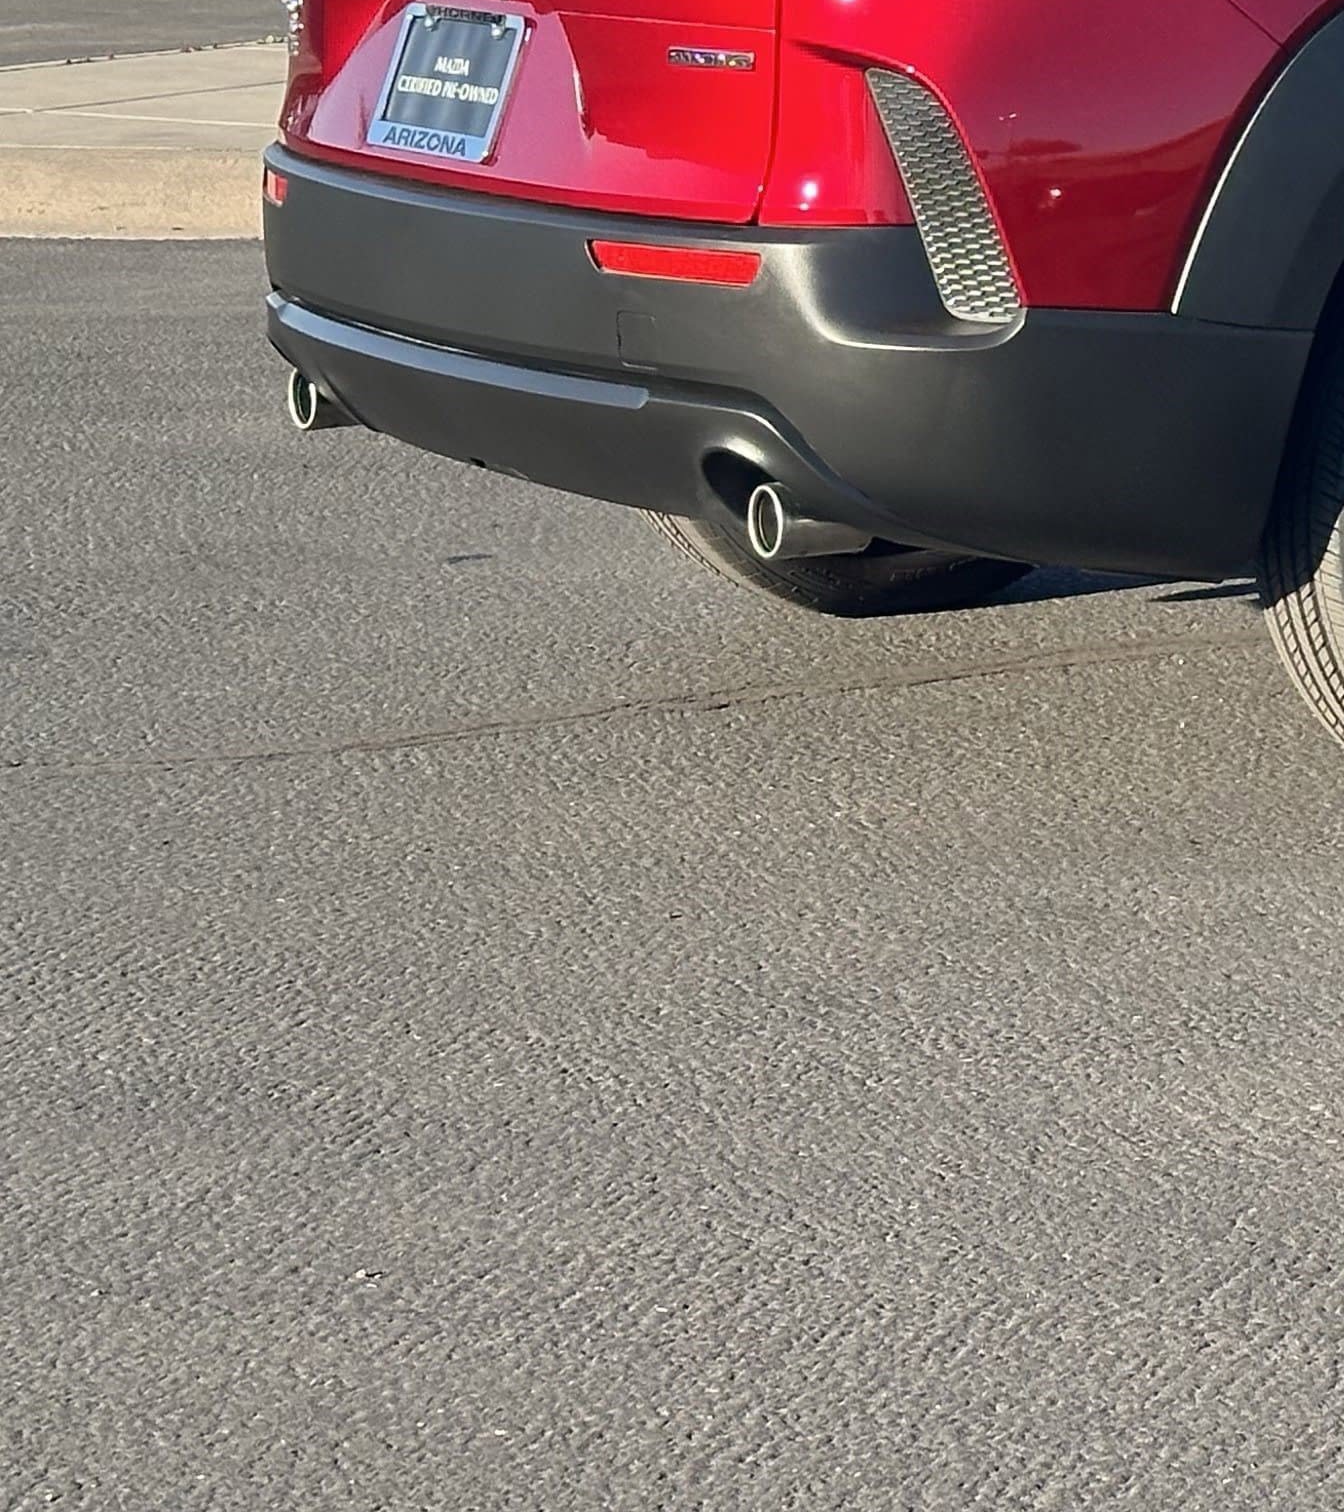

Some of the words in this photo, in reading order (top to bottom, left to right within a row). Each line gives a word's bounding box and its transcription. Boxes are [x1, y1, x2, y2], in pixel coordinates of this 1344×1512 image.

[434, 56, 470, 76] MAZDA
[397, 75, 442, 97] CERTIFIED
[442, 81, 499, 105] PRE-OWNED
[383, 126, 467, 157] ARIZONA
